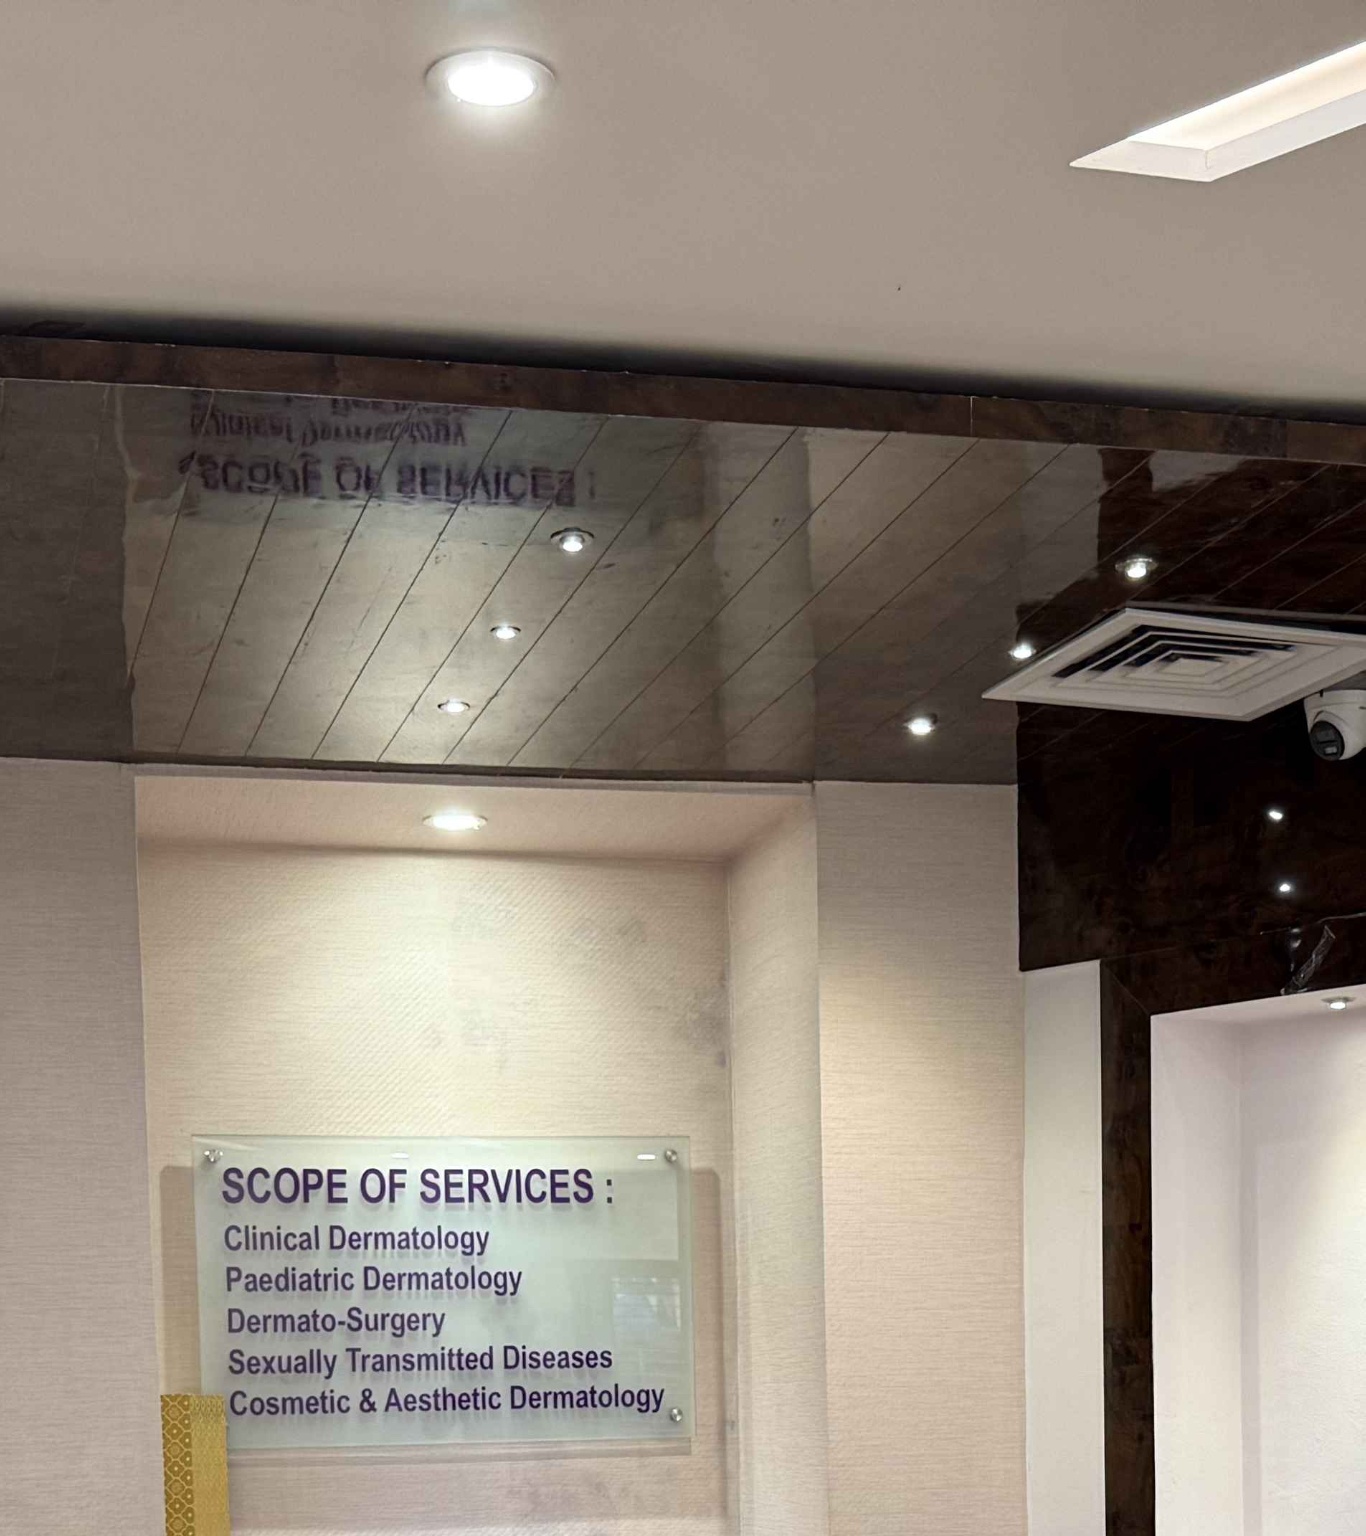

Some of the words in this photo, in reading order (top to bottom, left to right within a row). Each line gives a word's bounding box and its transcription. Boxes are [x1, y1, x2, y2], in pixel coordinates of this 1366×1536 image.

[222, 1167, 348, 1205] SCOPE
[359, 1168, 407, 1204] OF
[419, 1168, 595, 1205] SERVICES
[223, 1225, 320, 1252] Clinical
[328, 1225, 490, 1256] Dermatology
[225, 1266, 355, 1293] Paediatric
[362, 1265, 523, 1296] Dermatology
[227, 1307, 446, 1338] Dermato-Surgery
[228, 1348, 338, 1380] Sexually
[345, 1347, 495, 1374] Transmitted
[502, 1345, 614, 1371] Diseases
[230, 1389, 351, 1417] Cosmetic
[359, 1388, 377, 1414] &
[384, 1386, 502, 1413] Aesthetic
[509, 1384, 665, 1414] Dermatology
